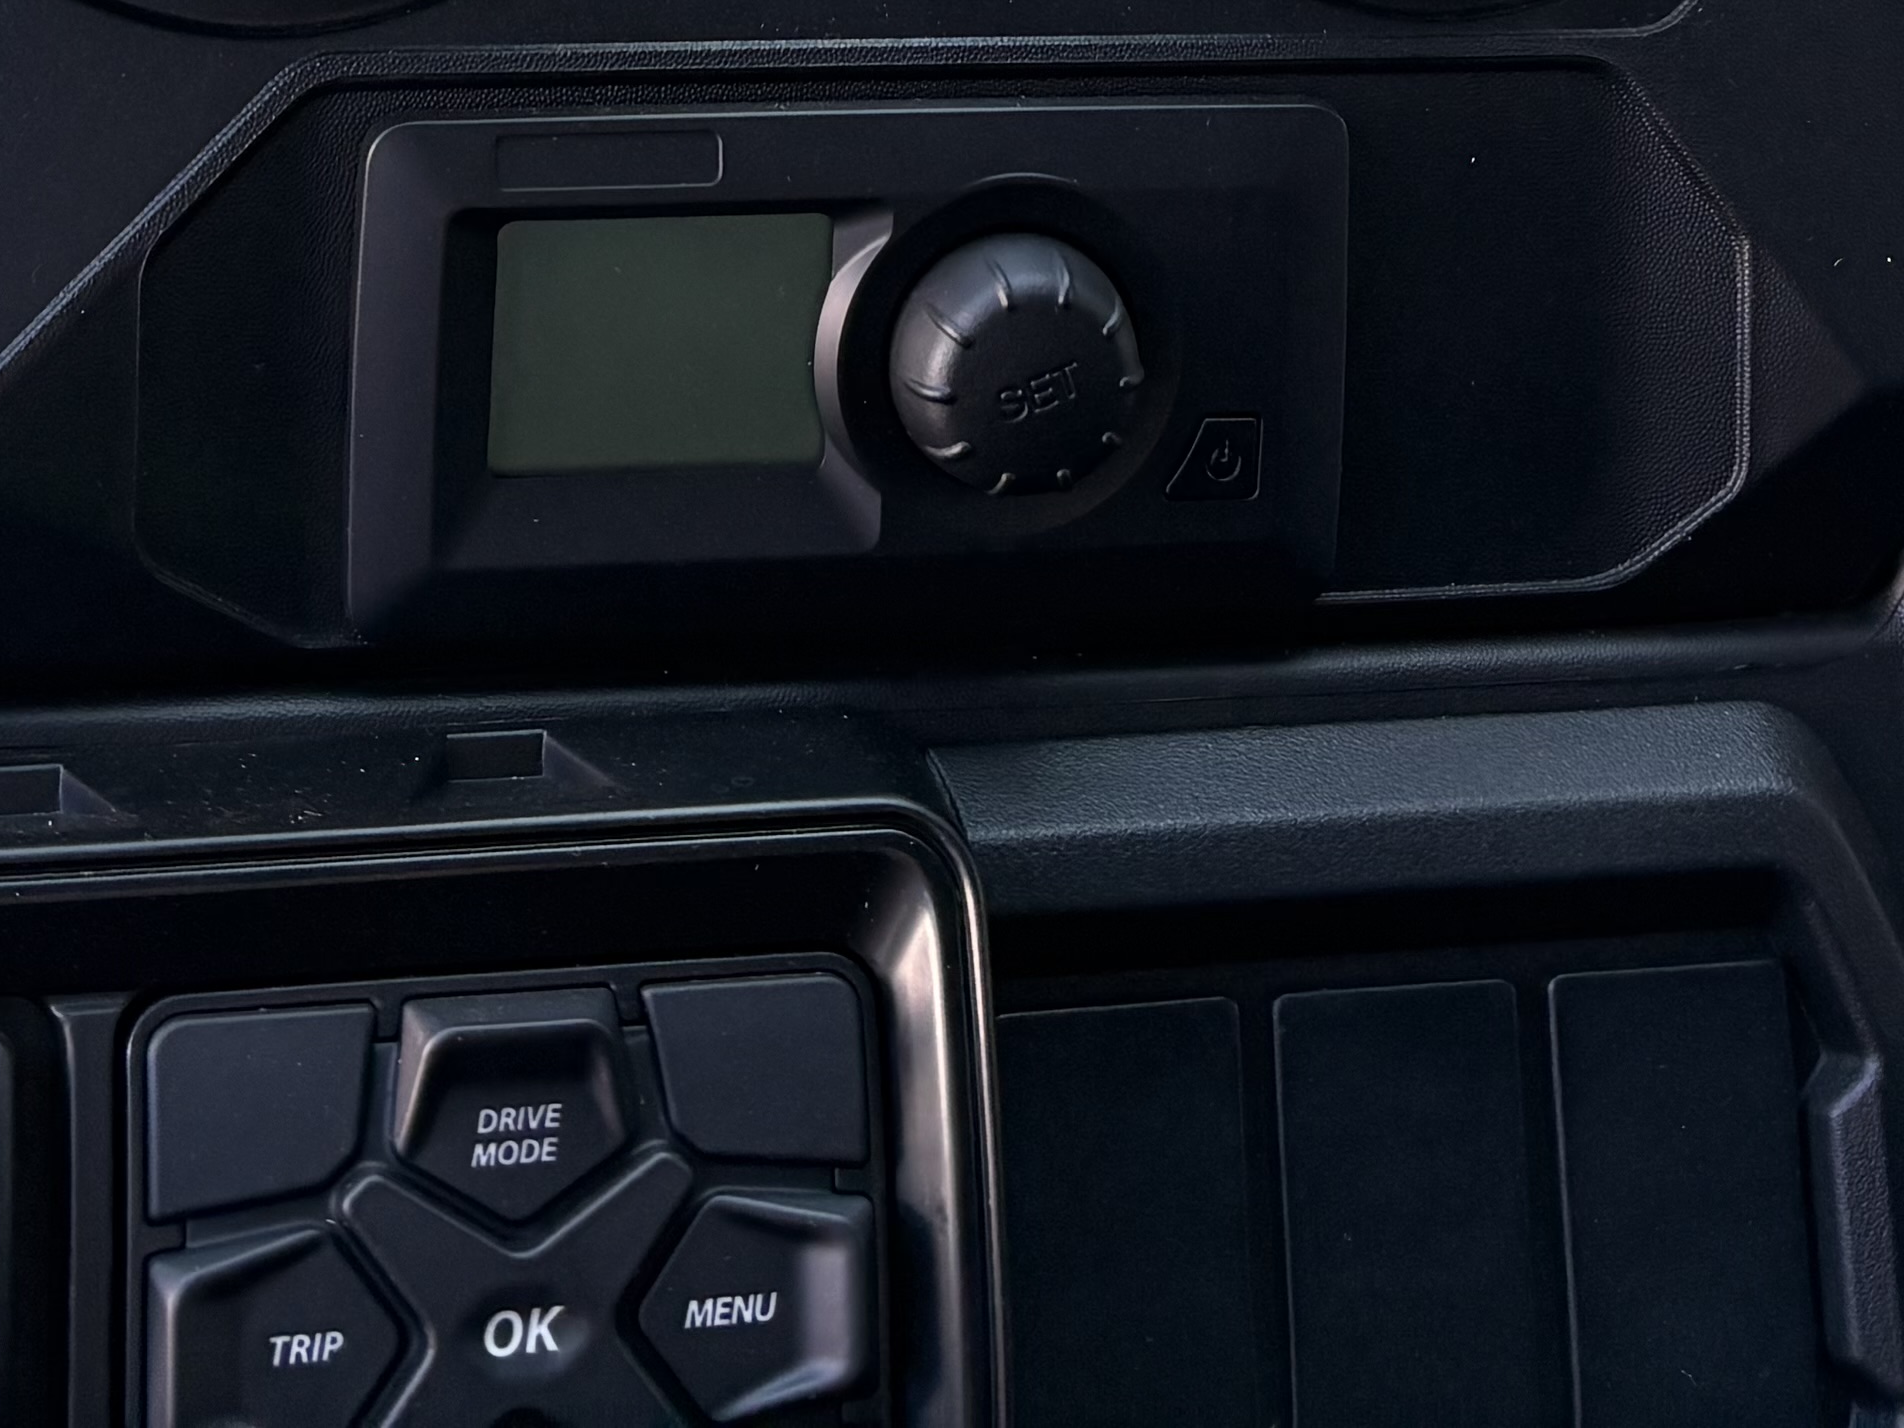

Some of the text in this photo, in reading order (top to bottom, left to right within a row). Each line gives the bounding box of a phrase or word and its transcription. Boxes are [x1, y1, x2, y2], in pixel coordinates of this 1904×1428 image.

[998, 361, 1080, 424] SET
[476, 1102, 563, 1136] DRIVE
[470, 1136, 559, 1169] MODE
[684, 1291, 779, 1330] MENU
[269, 1330, 345, 1367] TRIP
[483, 1305, 566, 1358] OK
